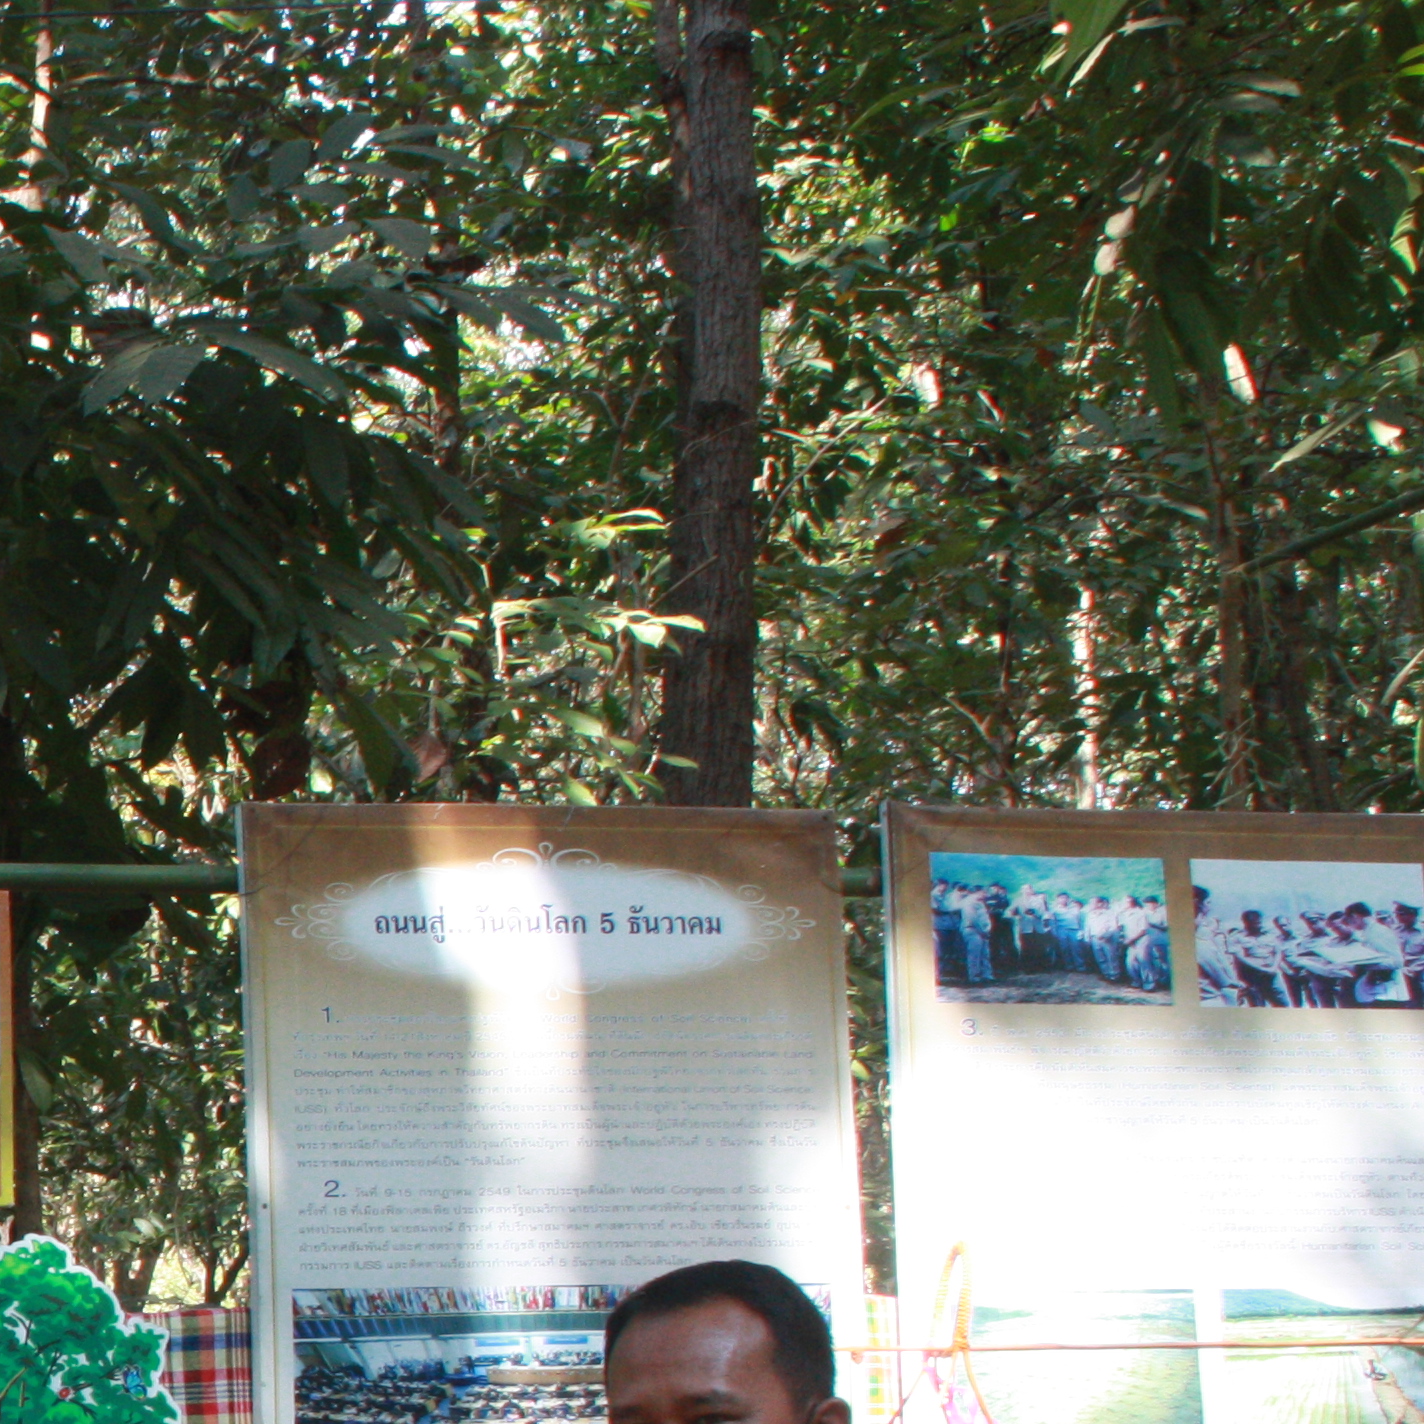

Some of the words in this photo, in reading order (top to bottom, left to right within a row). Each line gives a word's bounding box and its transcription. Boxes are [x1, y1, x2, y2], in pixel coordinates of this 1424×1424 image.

[600, 912, 615, 934] 5
[627, 904, 722, 936] ธันวาคม
[321, 1006, 340, 1023] 1.
[294, 1069, 374, 1078] Development
[324, 1180, 347, 1198] 2.
[630, 1185, 664, 1196] World
[671, 1185, 725, 1197] Congress
[731, 1184, 743, 1195] of
